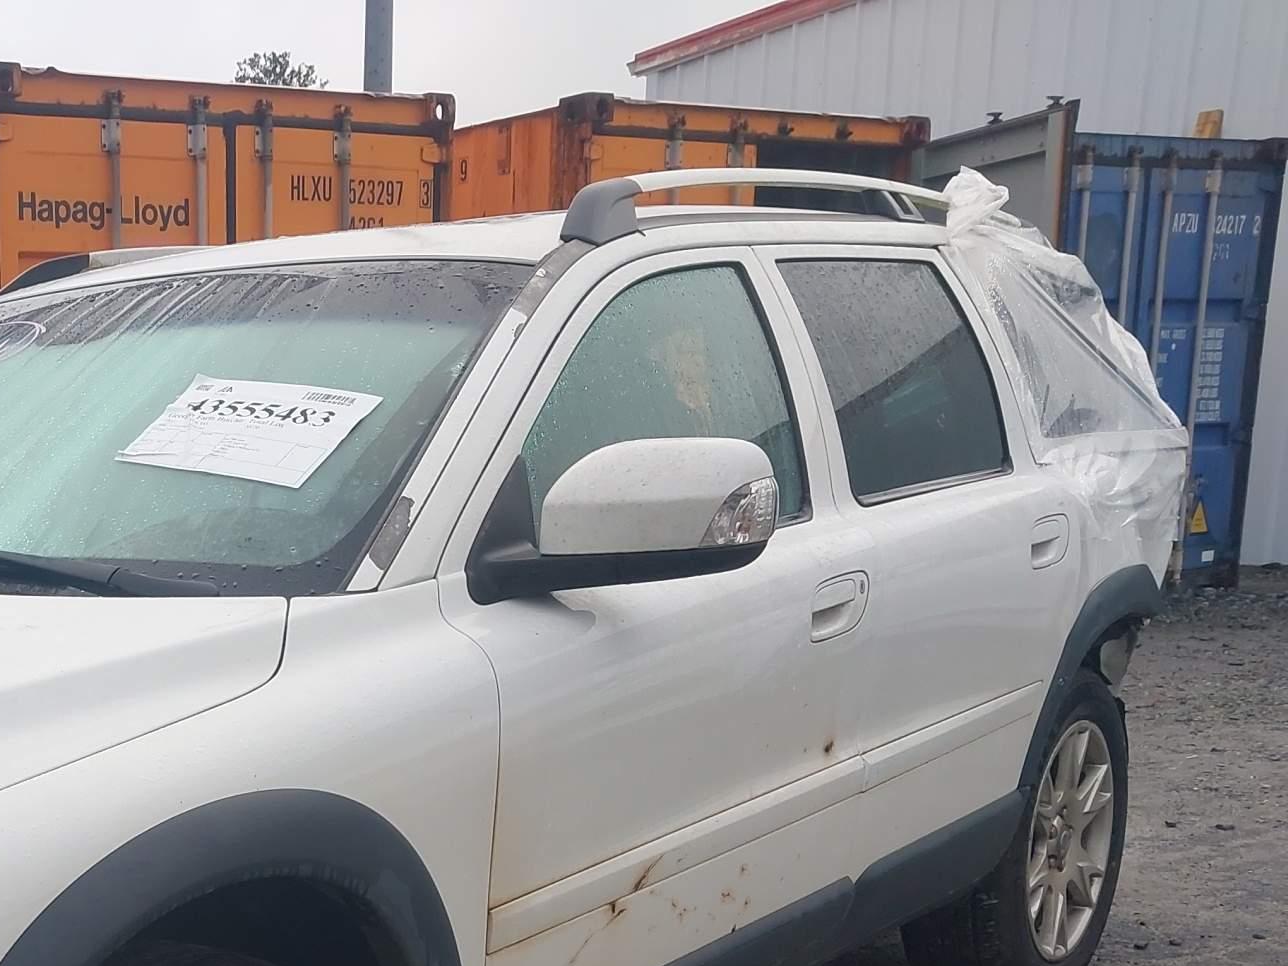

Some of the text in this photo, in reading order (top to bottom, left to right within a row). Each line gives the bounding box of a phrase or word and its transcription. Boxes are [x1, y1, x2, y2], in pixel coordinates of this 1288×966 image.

[460, 159, 468, 182] 9
[290, 175, 430, 207] HLXU 523297 3
[17, 191, 190, 232] Hapag-Lloyd
[1172, 212, 1200, 233] APZU
[1213, 215, 1247, 235] 24217
[187, 399, 336, 427] 43555483
